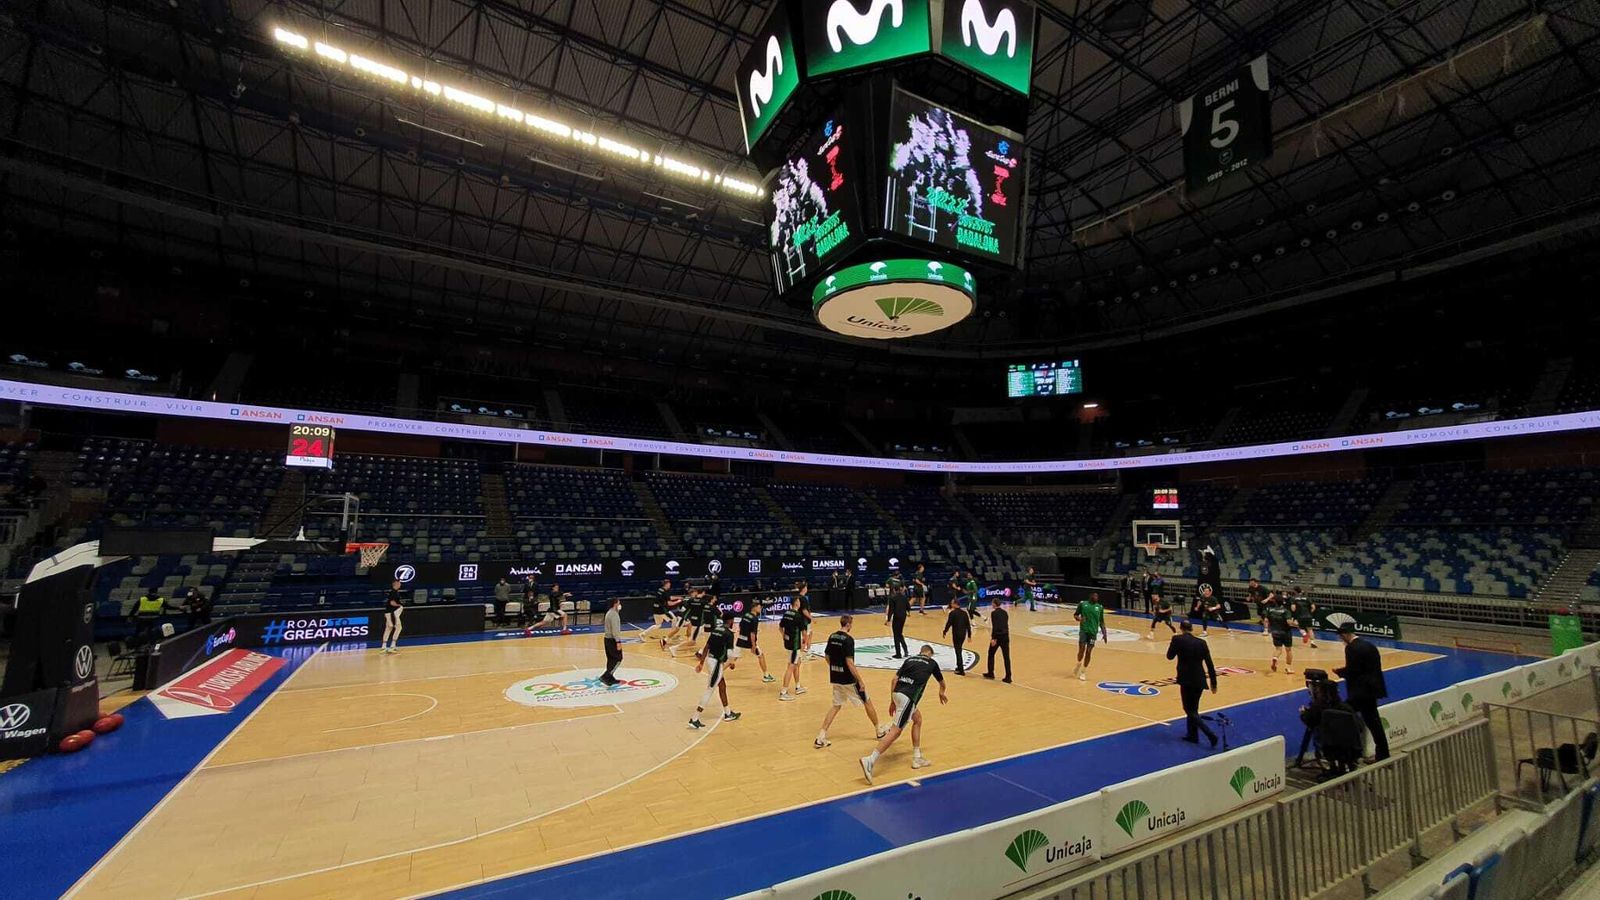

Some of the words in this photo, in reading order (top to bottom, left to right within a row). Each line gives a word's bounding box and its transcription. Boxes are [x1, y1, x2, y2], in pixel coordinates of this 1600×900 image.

[1204, 79, 1239, 106] BERNI
[1210, 100, 1239, 148] 5
[846, 314, 912, 333] Unicaja
[62, 392, 147, 407] CONSTRUIR
[166, 402, 202, 412] VIVIR
[242, 409, 282, 419] ANSAN
[308, 415, 344, 424] ANSAN
[293, 426, 330, 436] 20:09
[368, 420, 422, 430] PROMOVER
[435, 426, 487, 436] CONSTRUIR
[1407, 428, 1470, 440] PROMOVER
[1486, 419, 1561, 433] CONSTRUIR
[546, 435, 572, 443] ANSAN
[589, 439, 614, 447] ANSAN
[1301, 442, 1330, 450] ANSAN
[1350, 437, 1384, 446] ANSAN
[292, 439, 324, 456] 24
[565, 563, 602, 573] ANSAN
[284, 626, 368, 641] GREATNESS
[1354, 623, 1395, 635] Unicaja
[198, 664, 247, 693] TURKISH
[5, 728, 47, 738] Wagen
[1253, 773, 1281, 793] Unicaja
[1147, 808, 1186, 831] Unicaja
[1046, 836, 1092, 863] Unicaja
